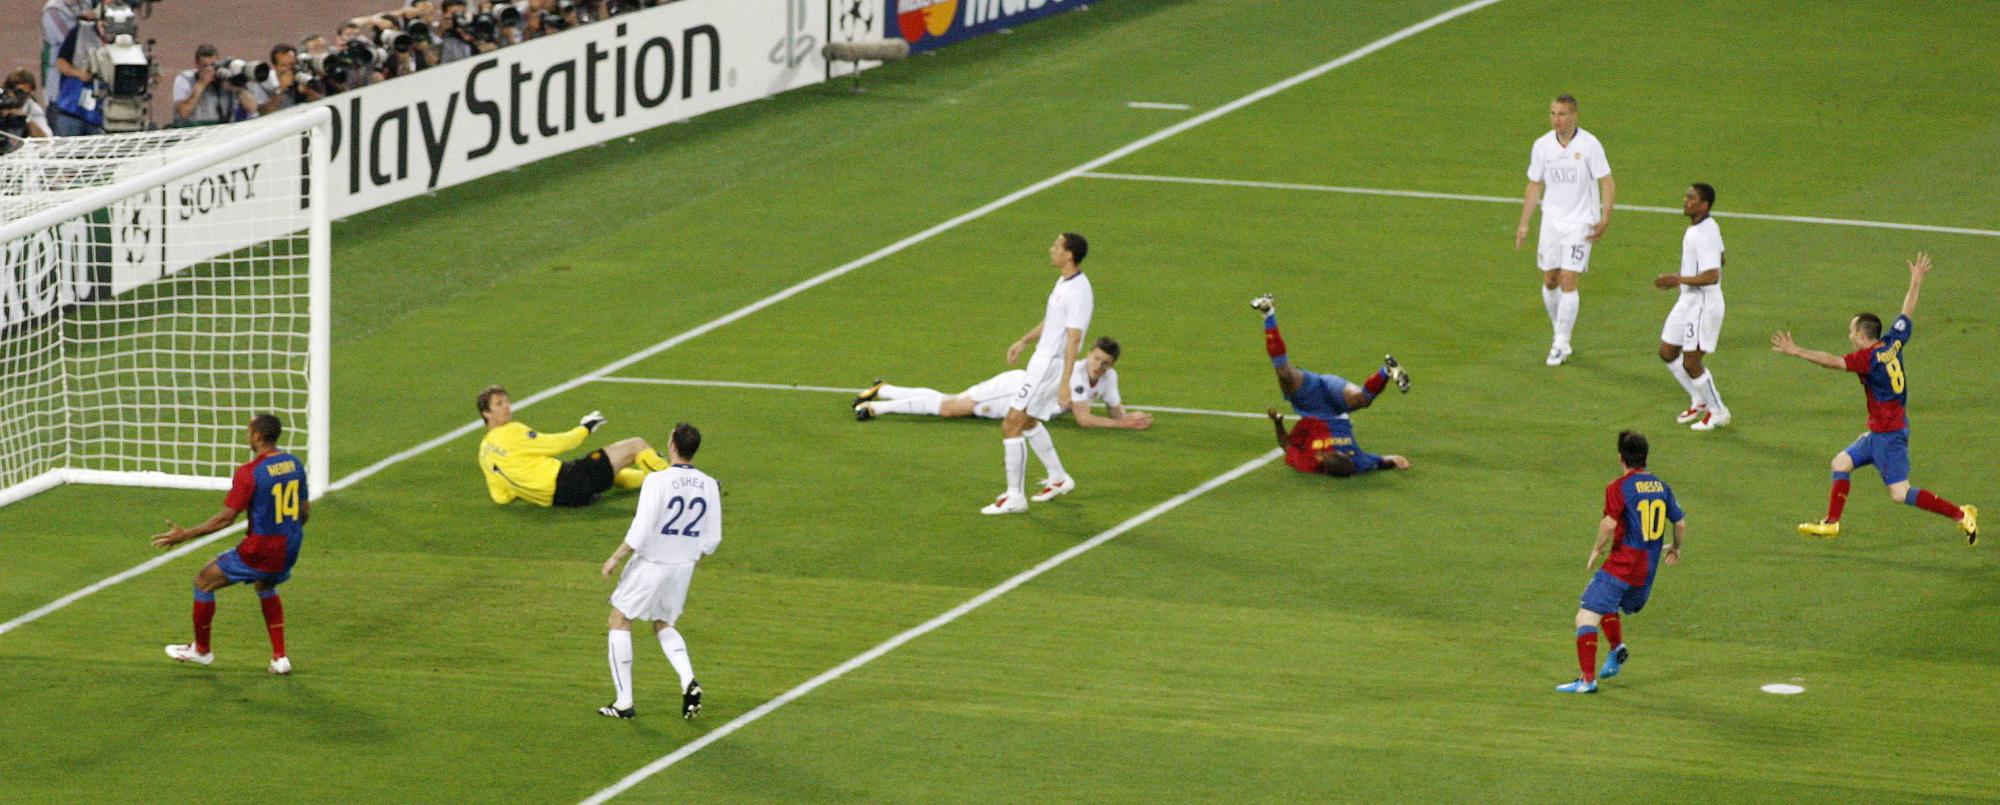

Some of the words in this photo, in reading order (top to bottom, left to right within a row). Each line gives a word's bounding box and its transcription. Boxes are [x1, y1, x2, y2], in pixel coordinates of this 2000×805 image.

[301, 22, 721, 210] PlayStation
[180, 163, 261, 220] SONY
[1571, 245, 1584, 260] 15
[1686, 322, 1695, 338] 3
[1018, 383, 1031, 398] 5
[1886, 356, 1905, 393] 8
[271, 479, 299, 524] 14
[661, 495, 707, 537] 22
[1637, 499, 1667, 541] 10
